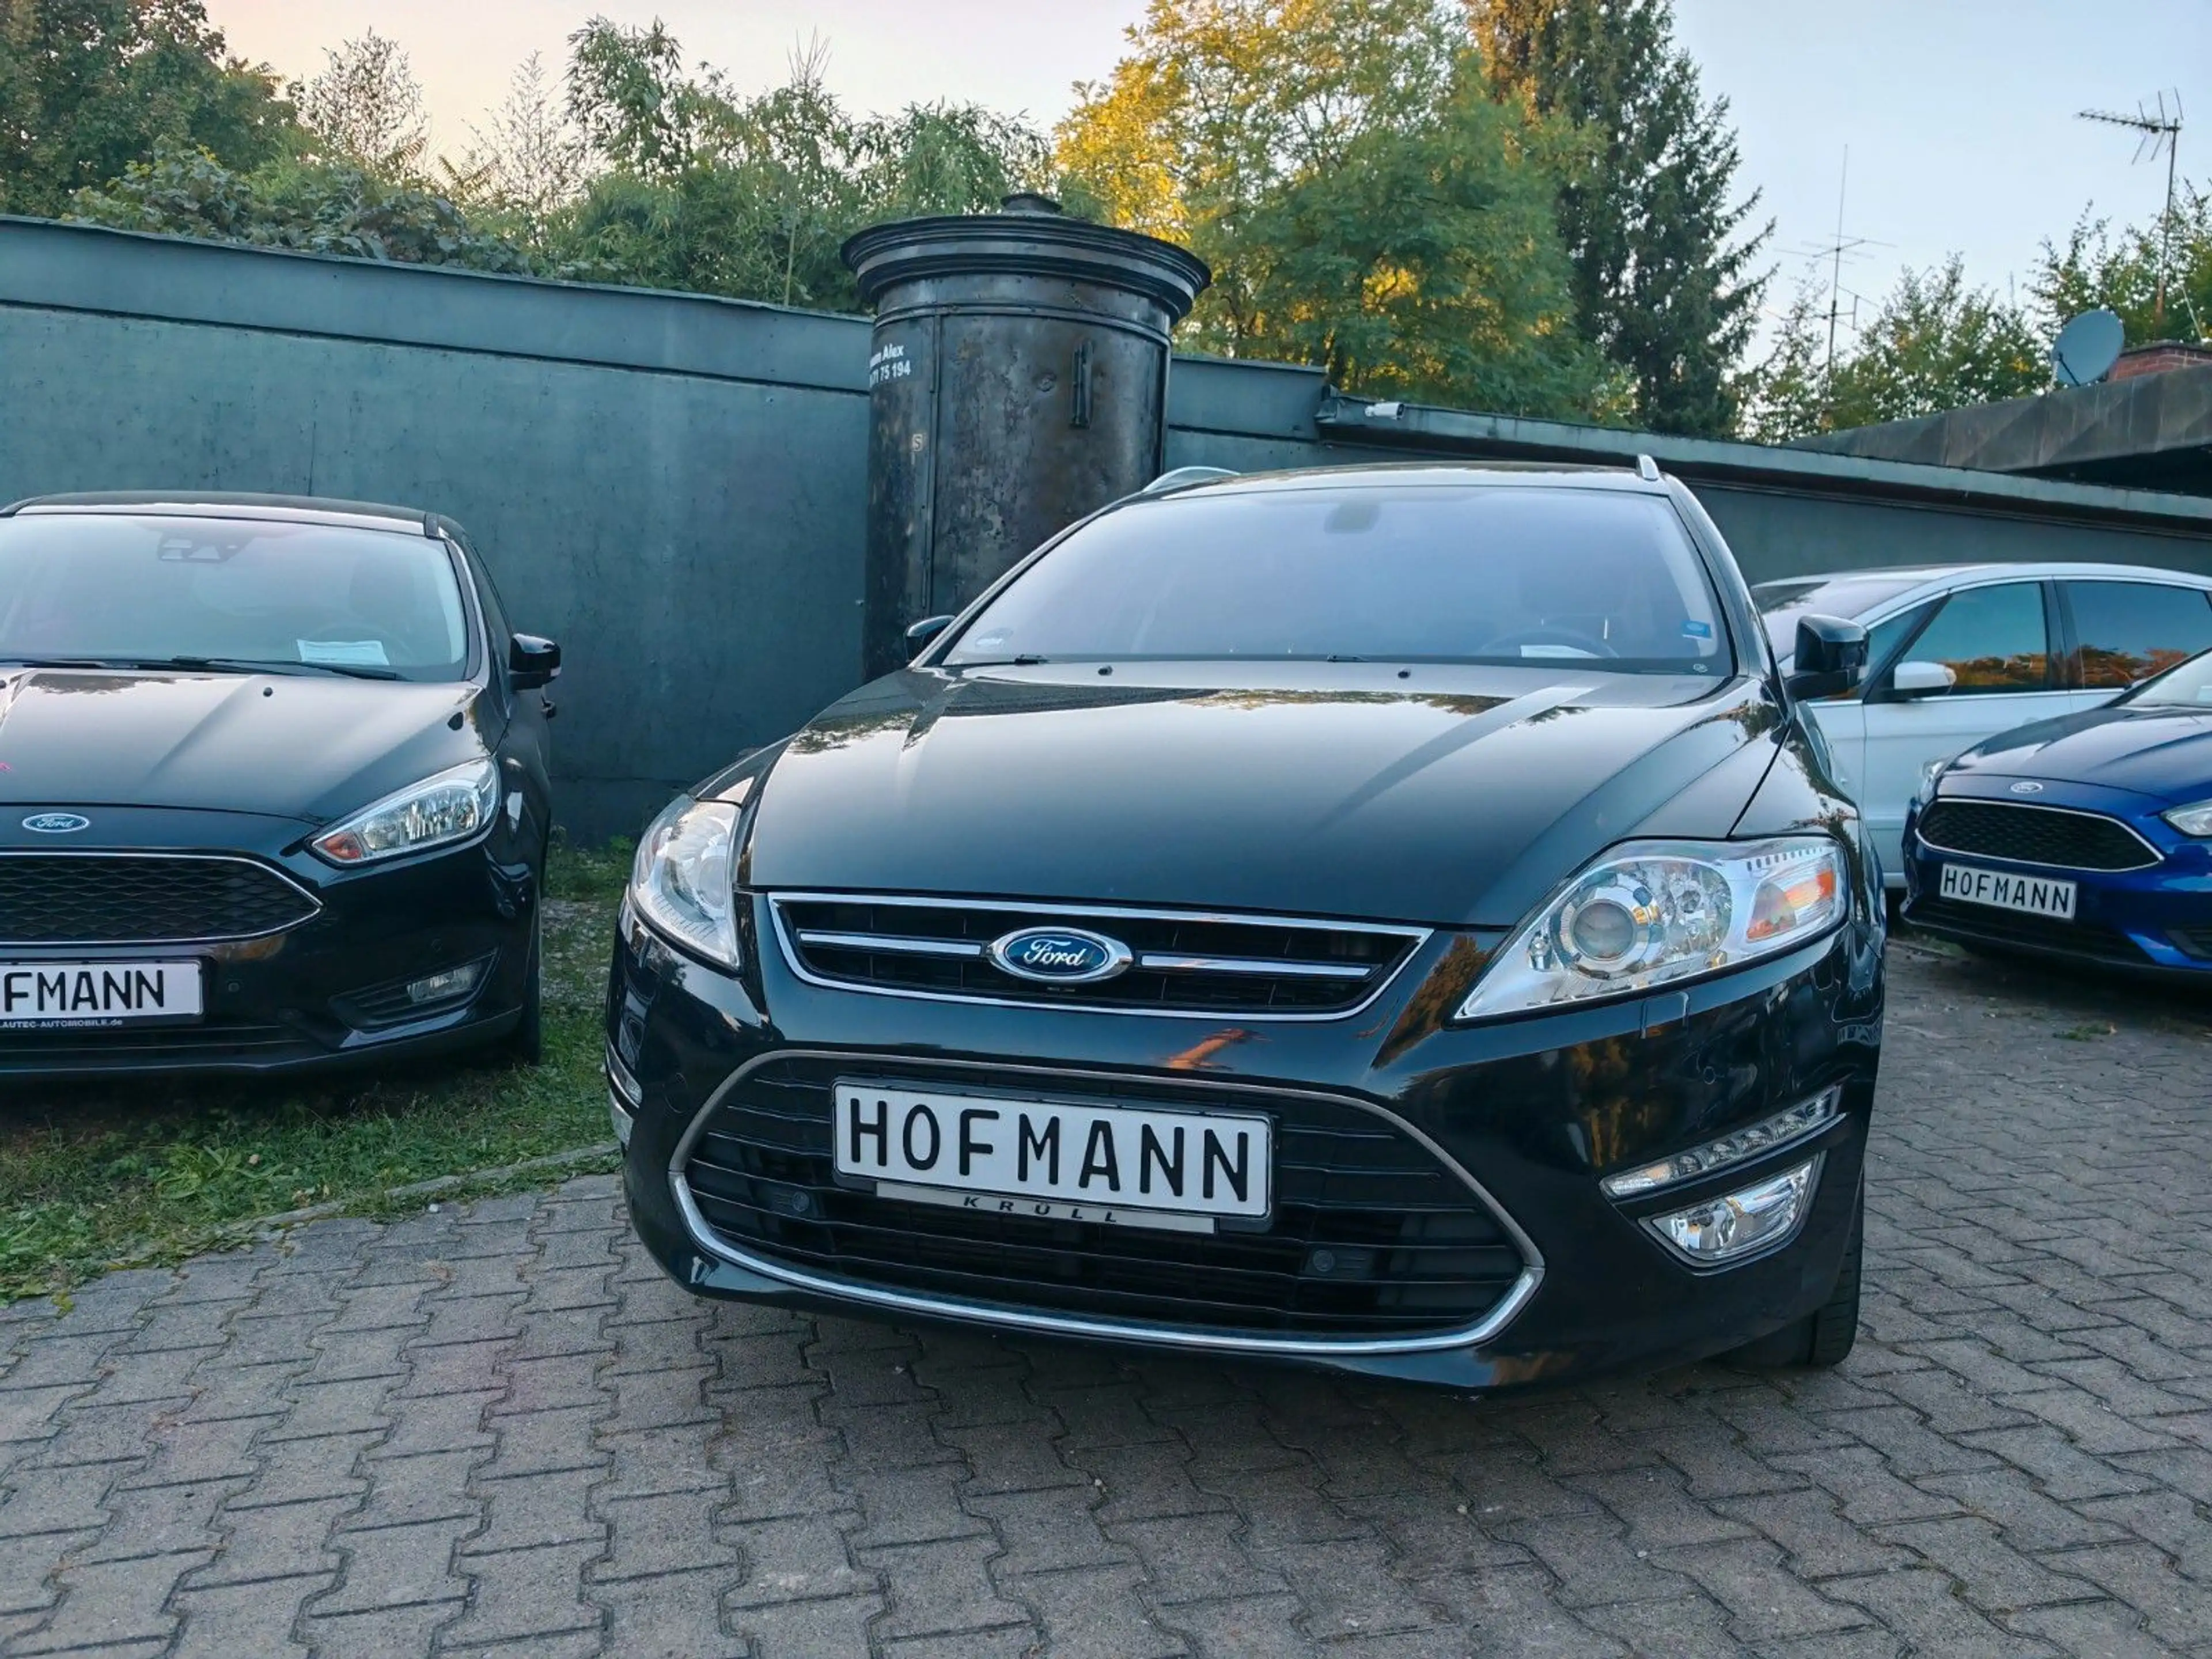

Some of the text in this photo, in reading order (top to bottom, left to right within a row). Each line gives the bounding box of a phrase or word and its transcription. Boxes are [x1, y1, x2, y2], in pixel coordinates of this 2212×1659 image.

[882, 343, 904, 361] Alex
[892, 359, 911, 378] 194
[36, 817, 75, 828] Ford
[1944, 868, 2070, 913] HOFMANN
[1024, 939, 1086, 966] Ford
[850, 1097, 1249, 1202] HOFMANN
